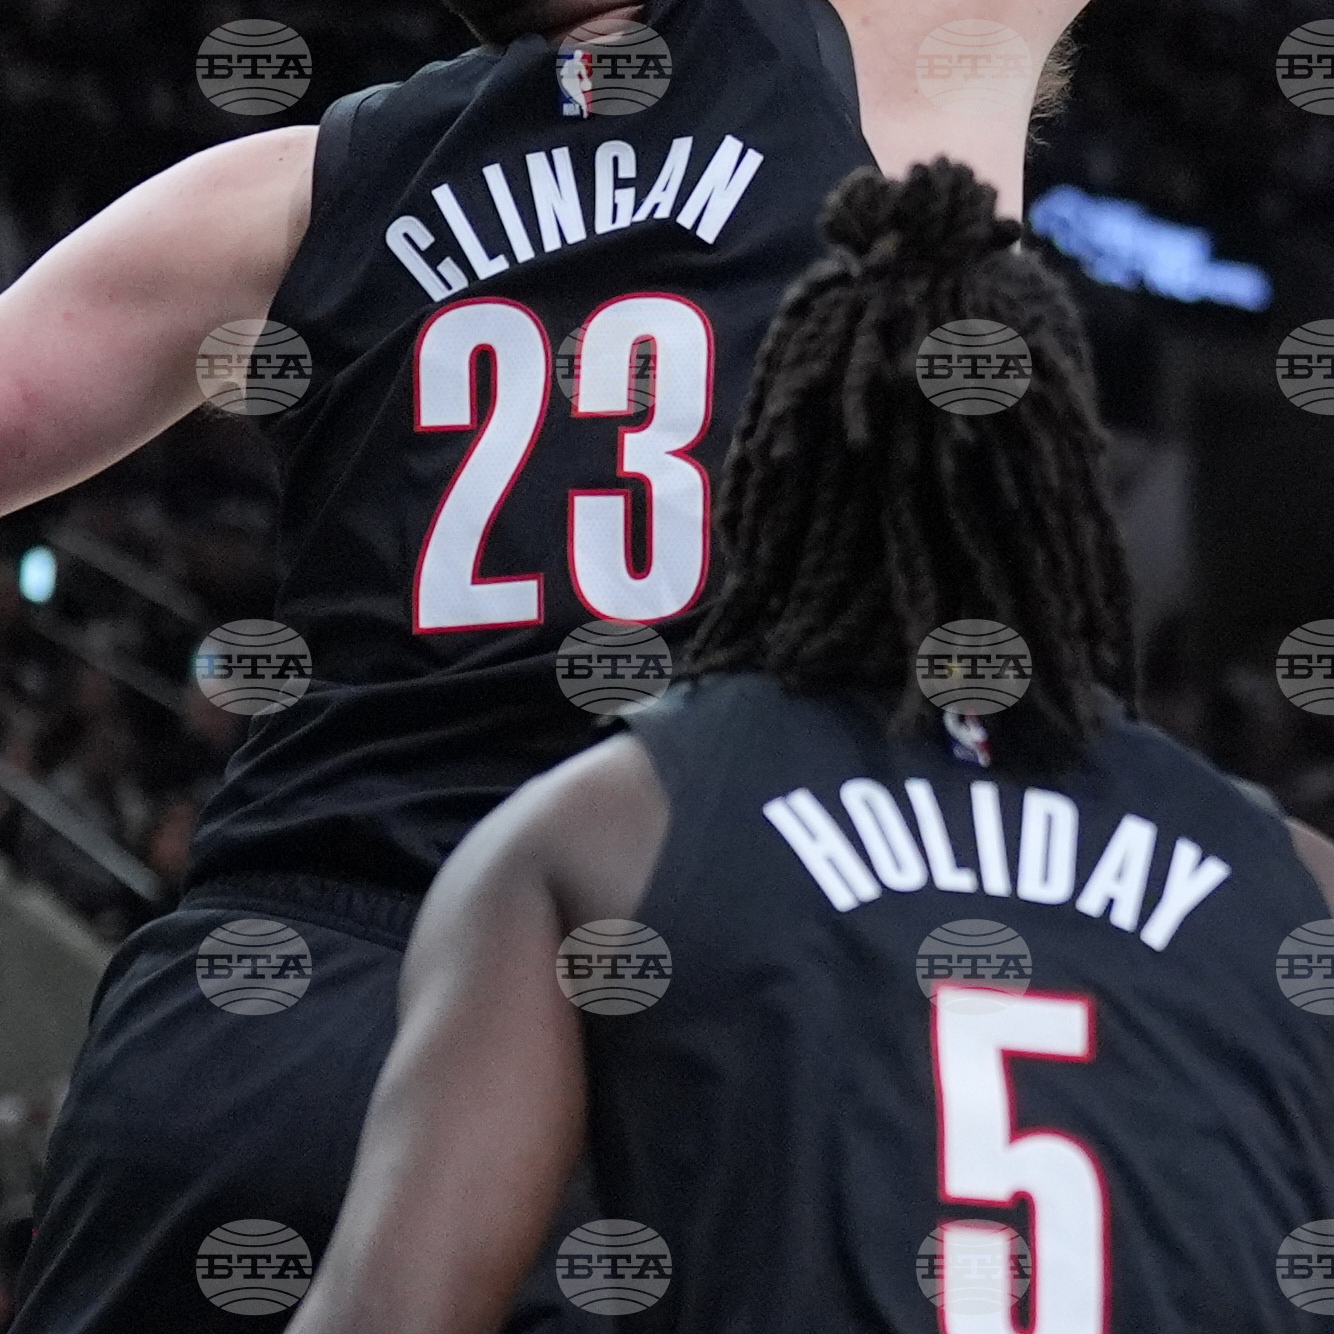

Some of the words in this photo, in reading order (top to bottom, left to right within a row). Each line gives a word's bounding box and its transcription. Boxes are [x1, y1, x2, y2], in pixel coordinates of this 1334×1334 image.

[385, 134, 764, 303] CLINGAN
[413, 291, 714, 634] 23
[762, 777, 1232, 952] HOLIDAY
